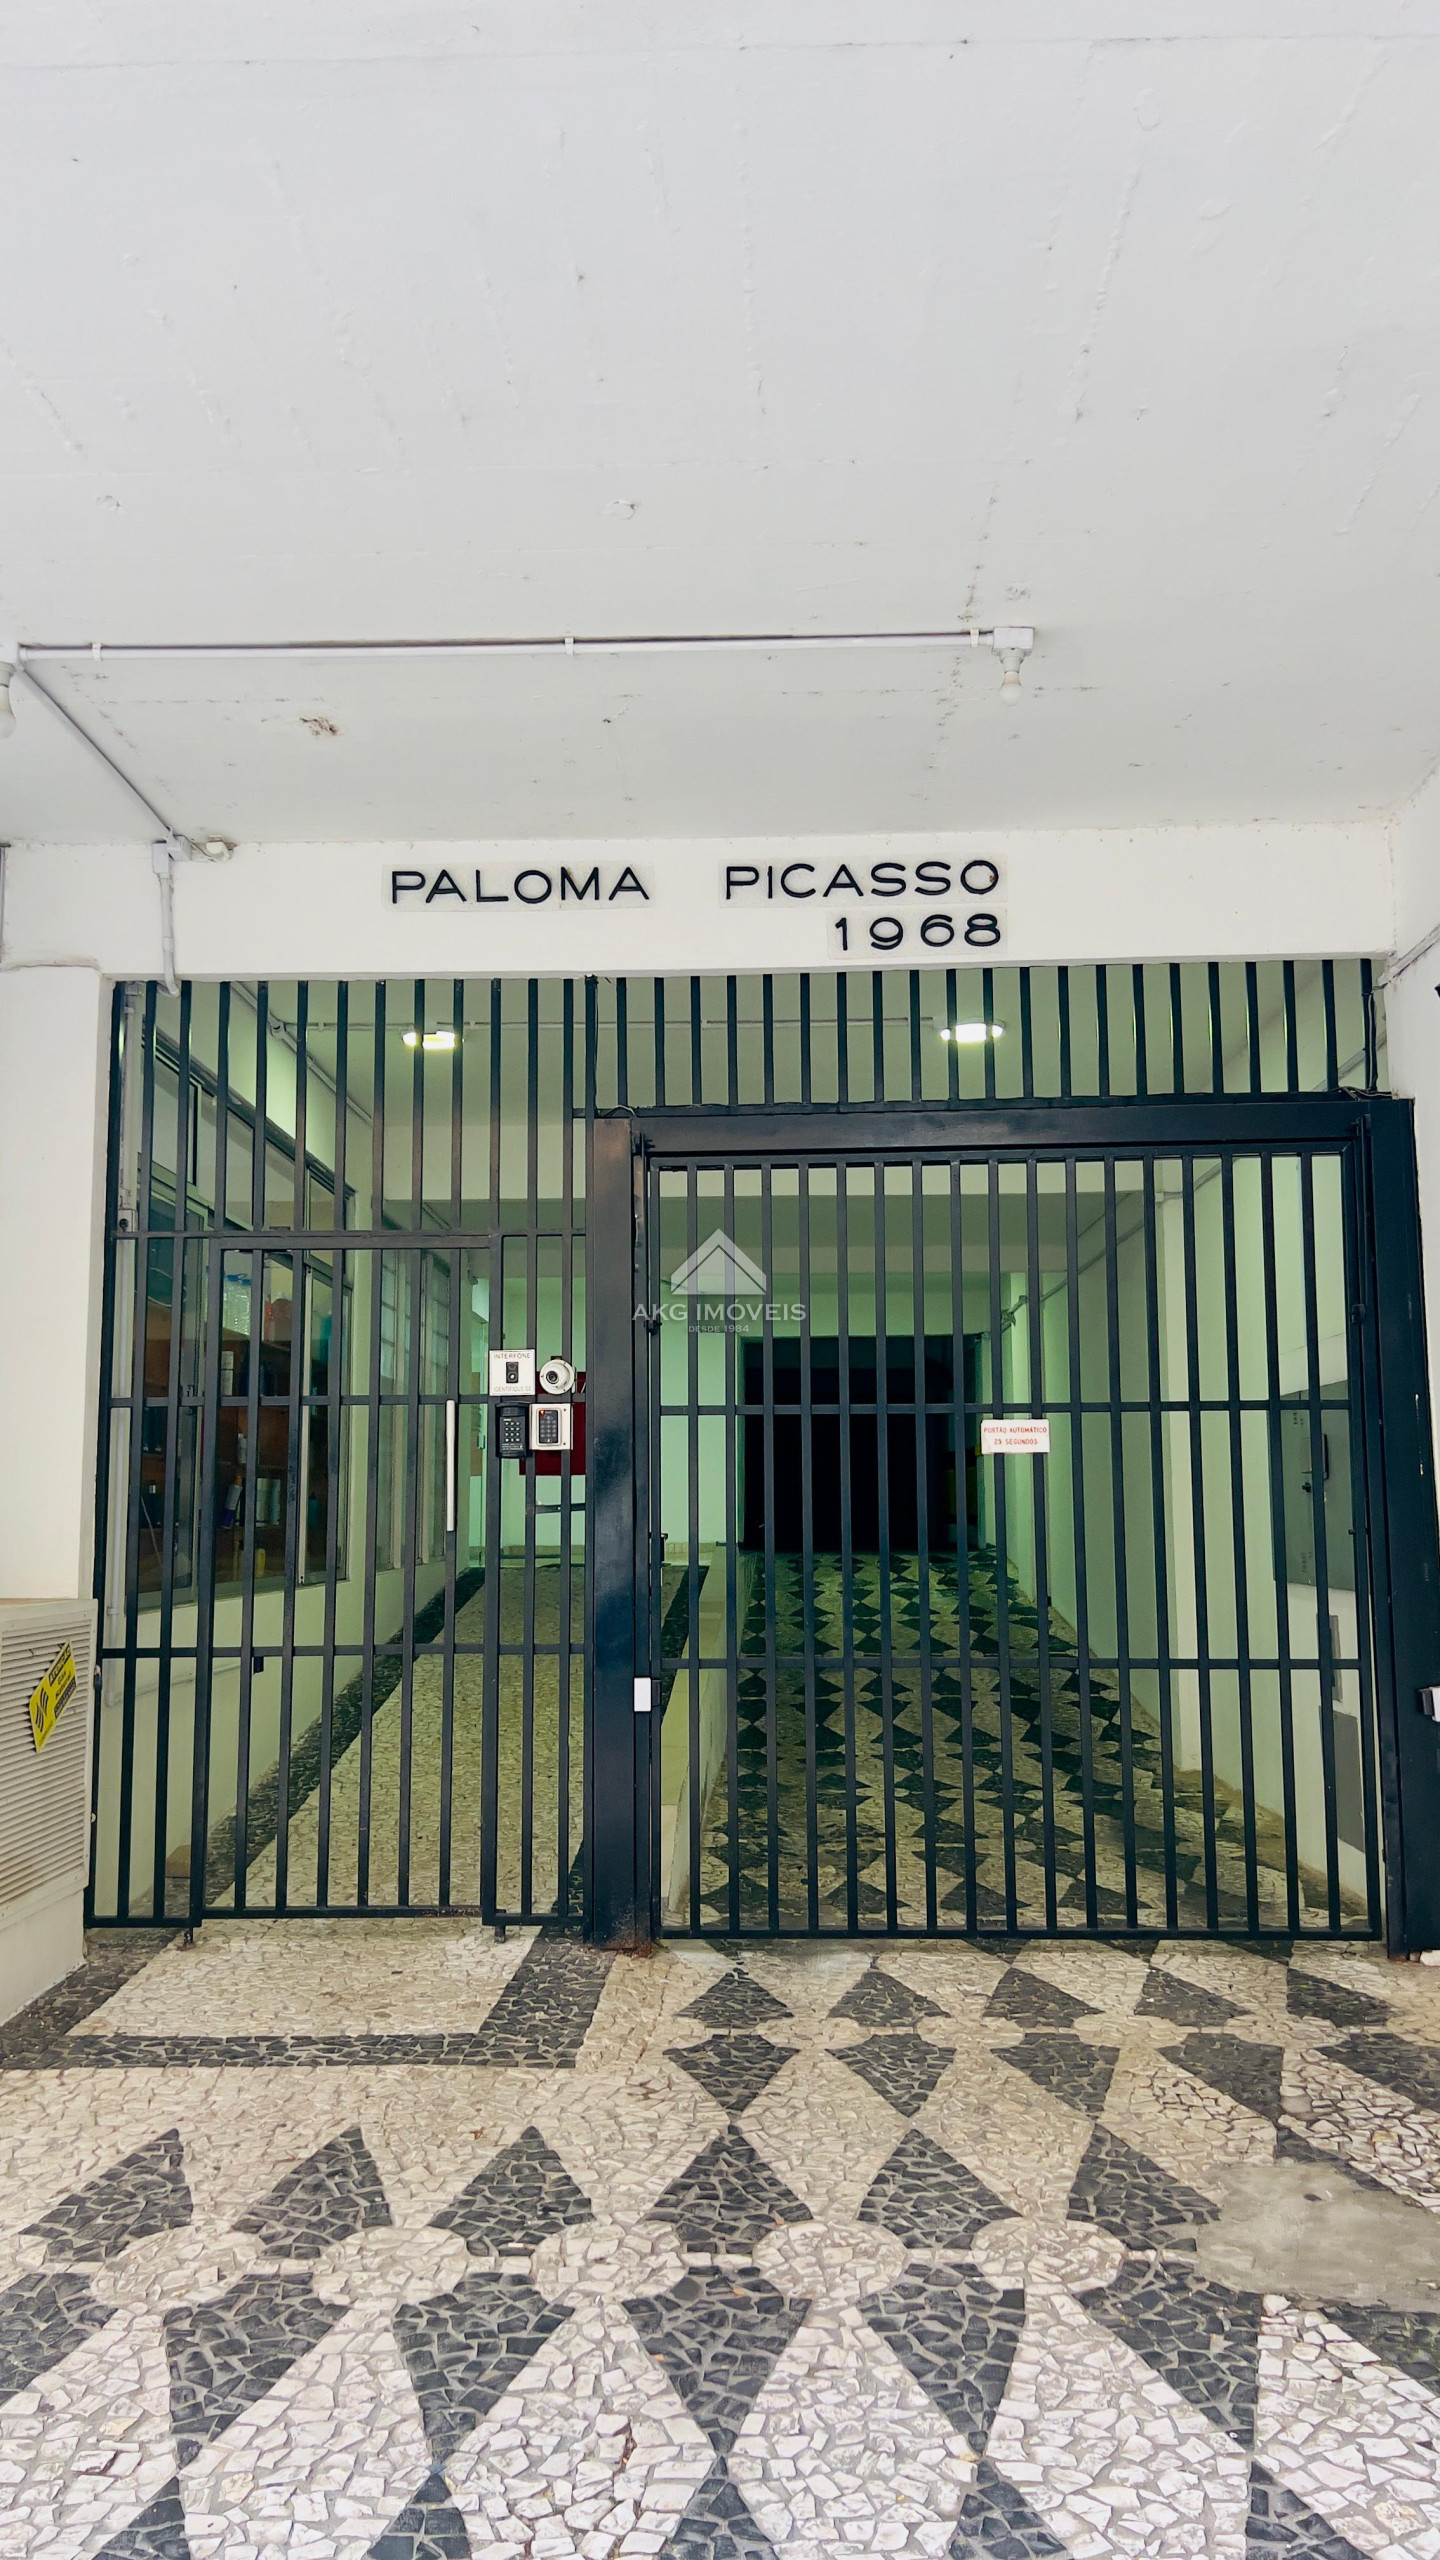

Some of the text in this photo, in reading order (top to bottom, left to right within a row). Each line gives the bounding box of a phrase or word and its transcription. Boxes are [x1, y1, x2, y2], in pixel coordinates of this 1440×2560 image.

[390, 859, 999, 905] PALOMA PICASSO
[833, 913, 1001, 952] 1968
